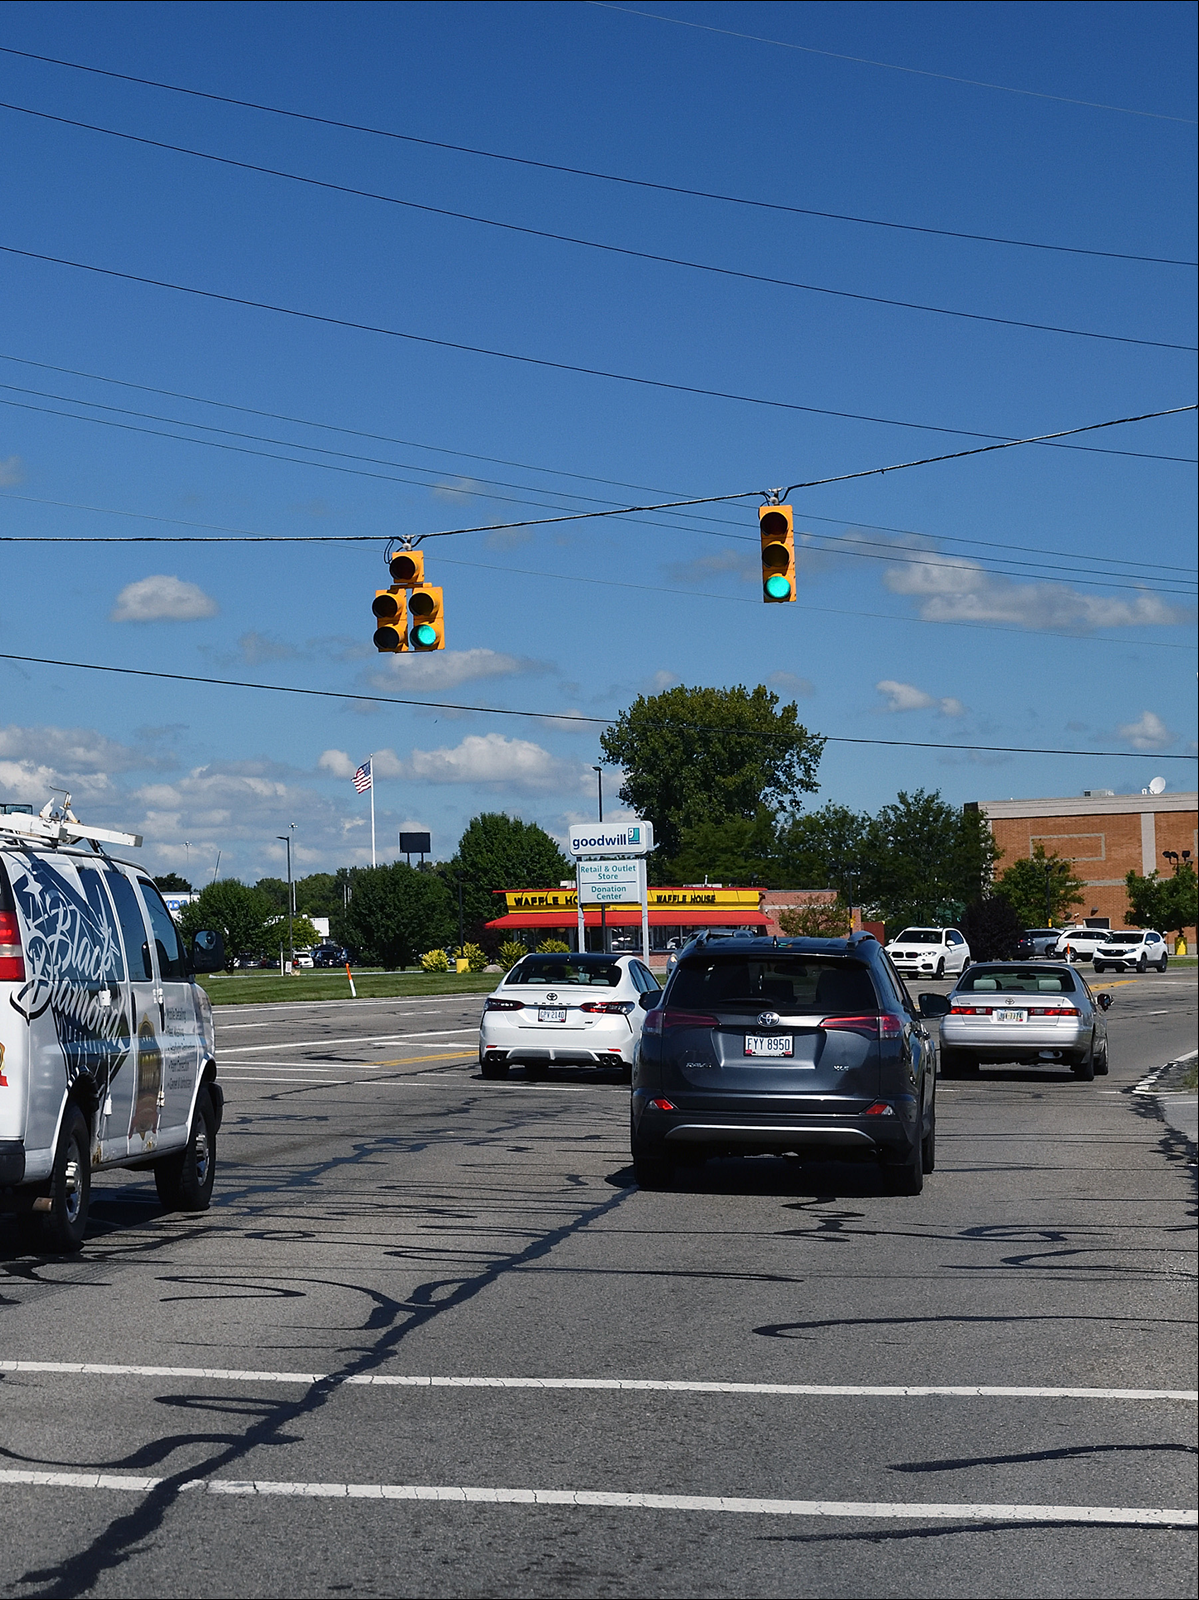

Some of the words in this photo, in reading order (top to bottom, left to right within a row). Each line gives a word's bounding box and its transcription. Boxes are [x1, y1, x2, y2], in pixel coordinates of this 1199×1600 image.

[572, 833, 627, 850] goodwill
[580, 865, 602, 873] Retail
[611, 864, 636, 872] Outlet
[597, 872, 619, 880] Store
[591, 885, 627, 893] Donation
[514, 896, 560, 906] WAFFLE
[656, 894, 687, 904] WAFFLE
[690, 894, 716, 904] HOUSE
[747, 1038, 764, 1050] FYY
[767, 1038, 790, 1051] 8950
